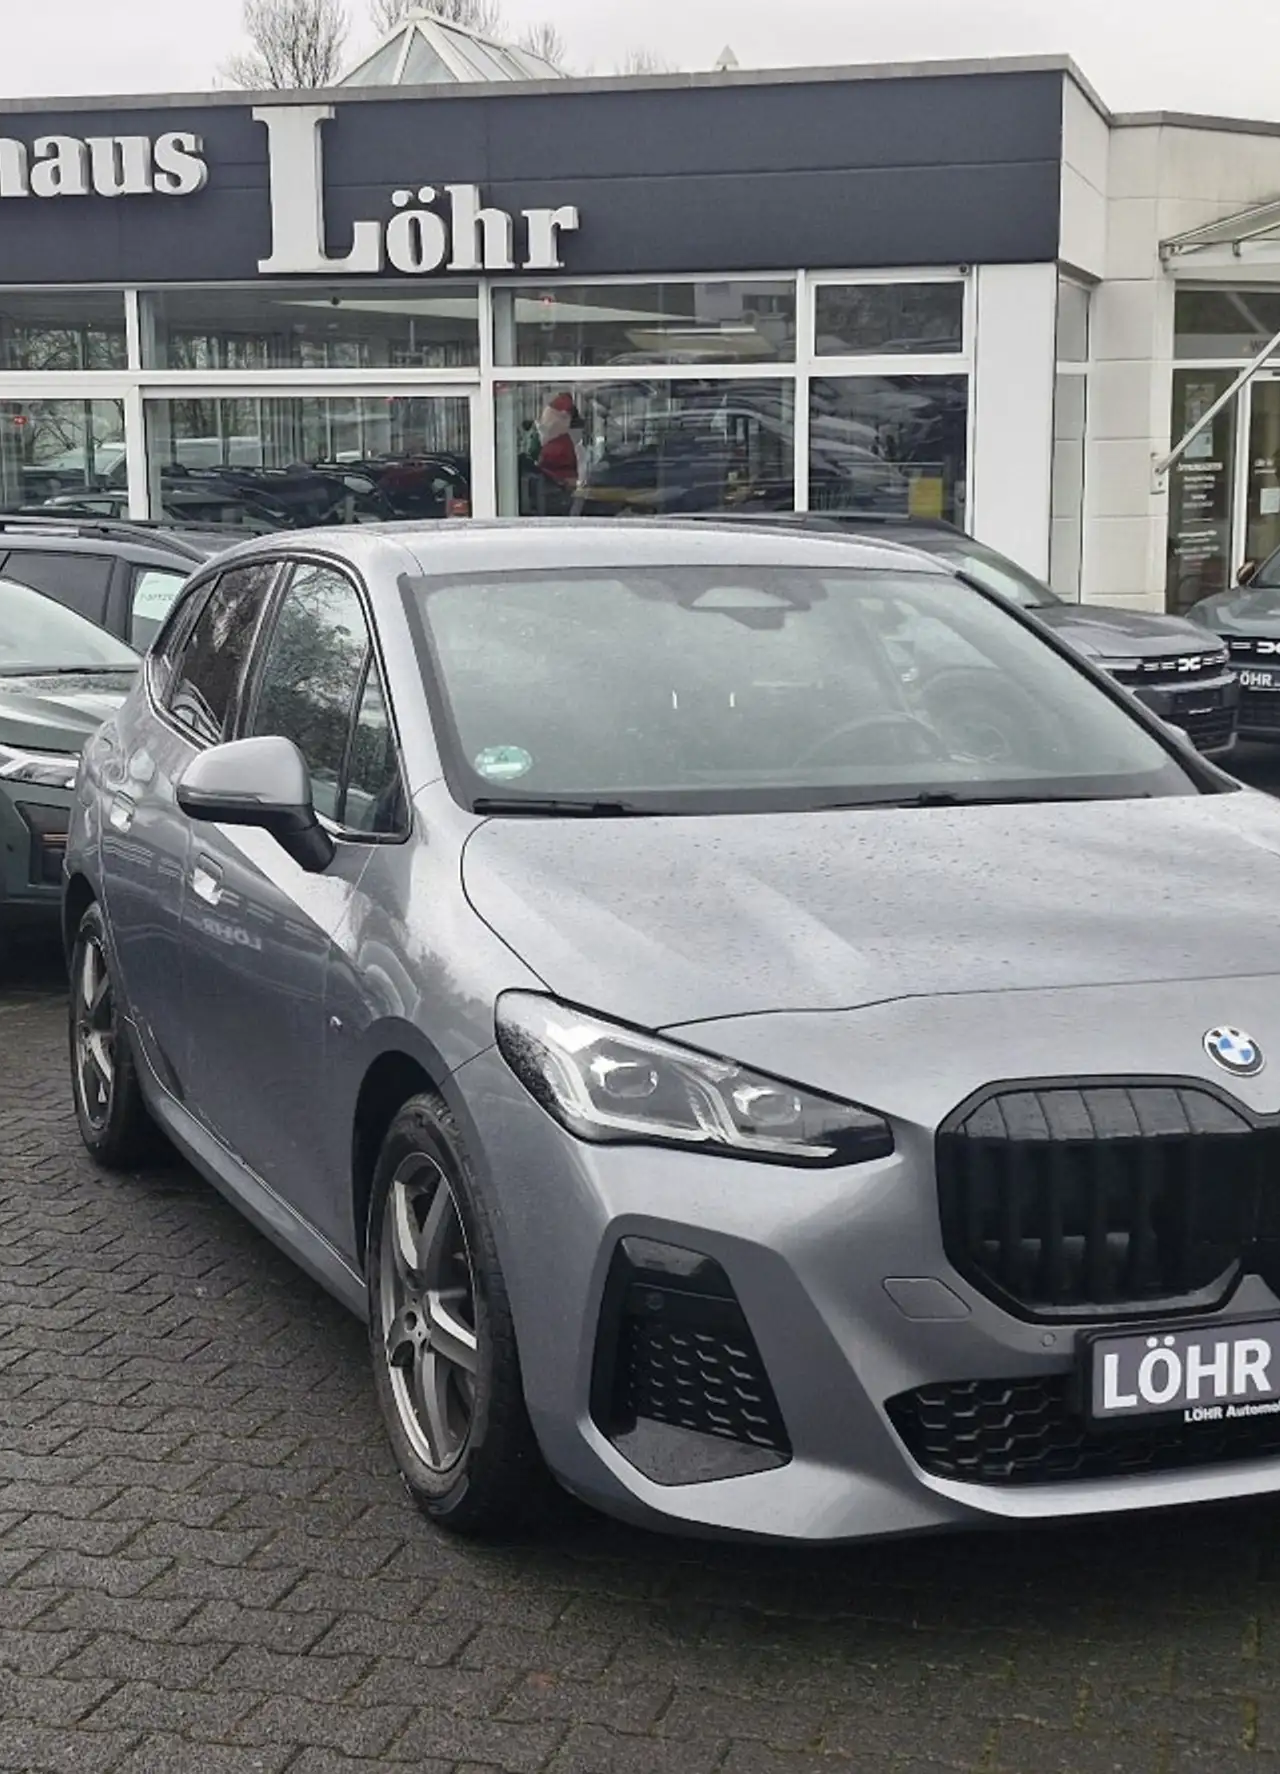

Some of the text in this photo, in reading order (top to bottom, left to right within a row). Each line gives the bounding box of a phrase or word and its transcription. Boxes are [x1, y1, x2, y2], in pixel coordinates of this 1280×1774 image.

[251, 105, 581, 274] Löhr
[1239, 670, 1273, 687] ÖHR
[1103, 1335, 1272, 1410] LÖHR
[1184, 1406, 1223, 1423] LÖHR
